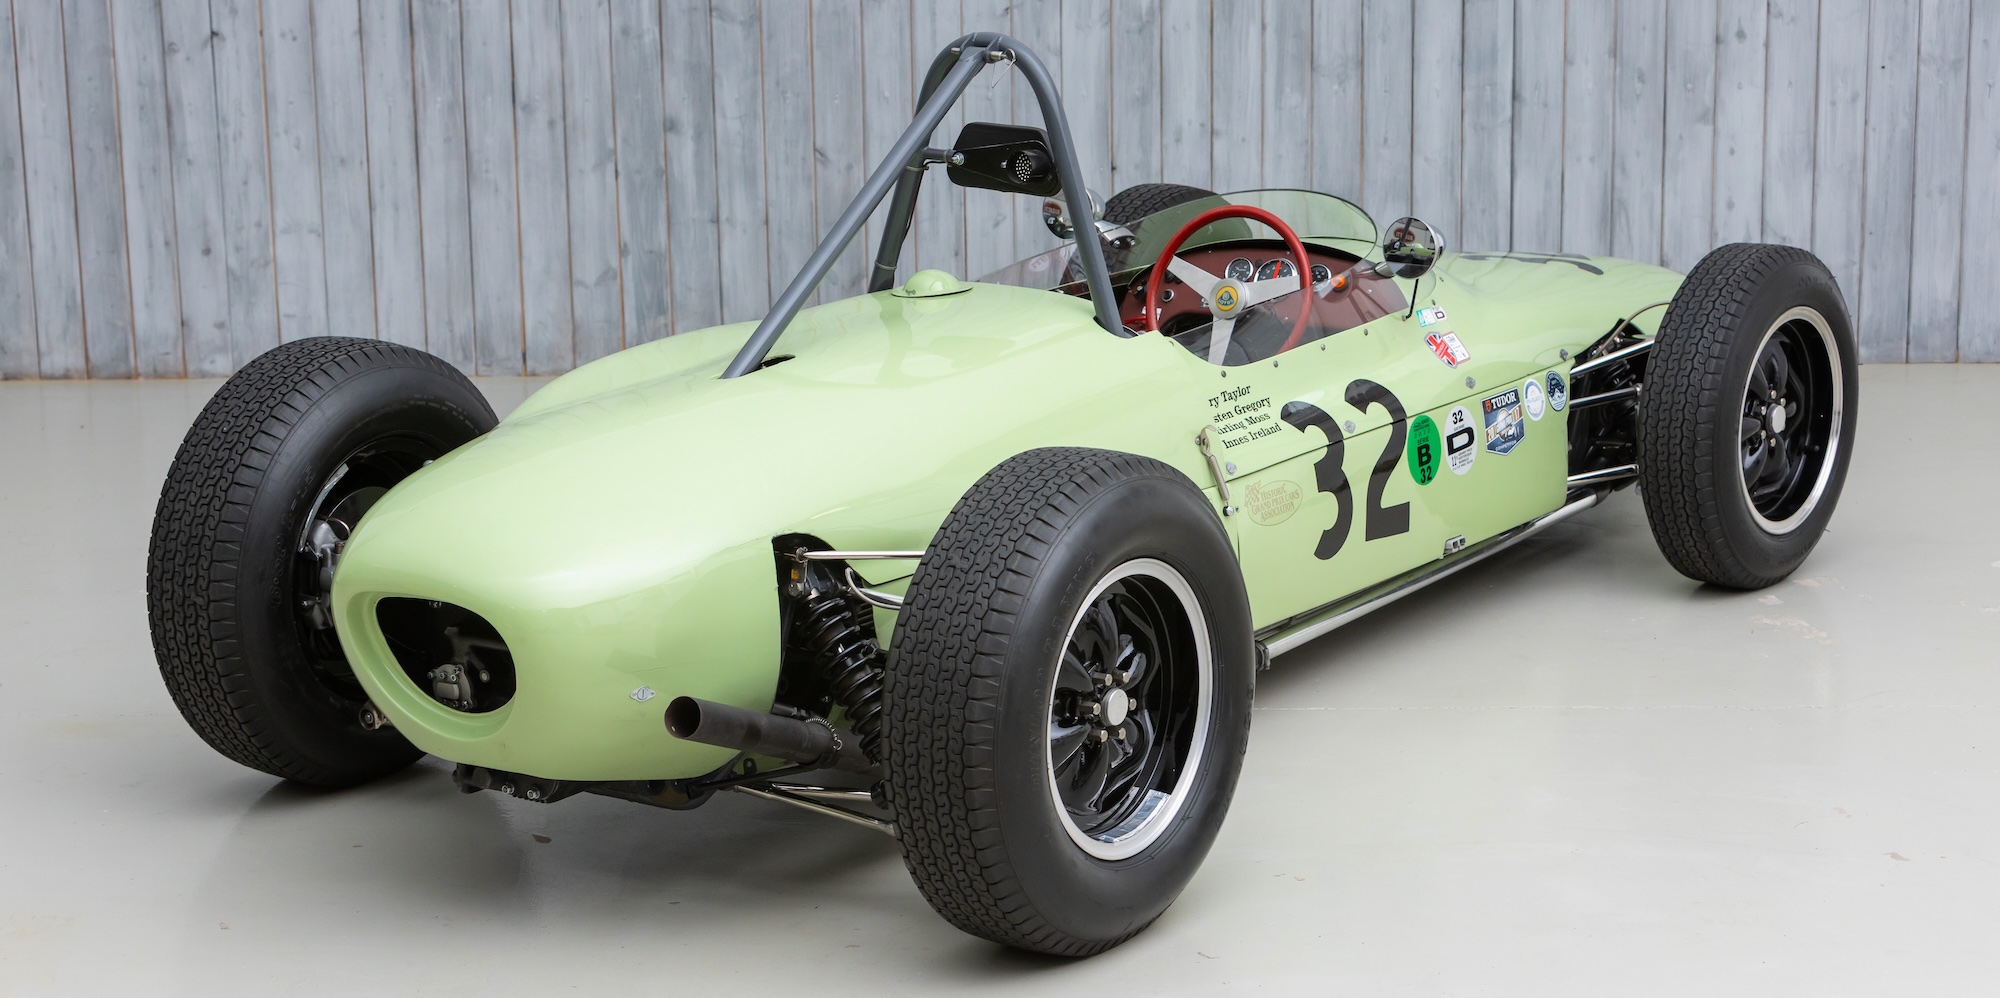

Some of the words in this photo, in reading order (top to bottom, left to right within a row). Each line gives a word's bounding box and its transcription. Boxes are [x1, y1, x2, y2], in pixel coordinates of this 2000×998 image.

[1208, 396, 1219, 408] ry
[1220, 385, 1251, 403] Taylor
[1491, 391, 1517, 410] TUDOR
[1213, 409, 1234, 423] sten
[1234, 396, 1272, 416] Gregory
[1244, 412, 1271, 426] Moss
[1452, 409, 1464, 425] 32
[1222, 434, 1249, 449] Innes
[1248, 422, 1282, 441] Ireland
[1446, 426, 1475, 456] D
[1417, 443, 1432, 468] B
[1280, 378, 1411, 561] 32
[1420, 465, 1433, 484] 32
